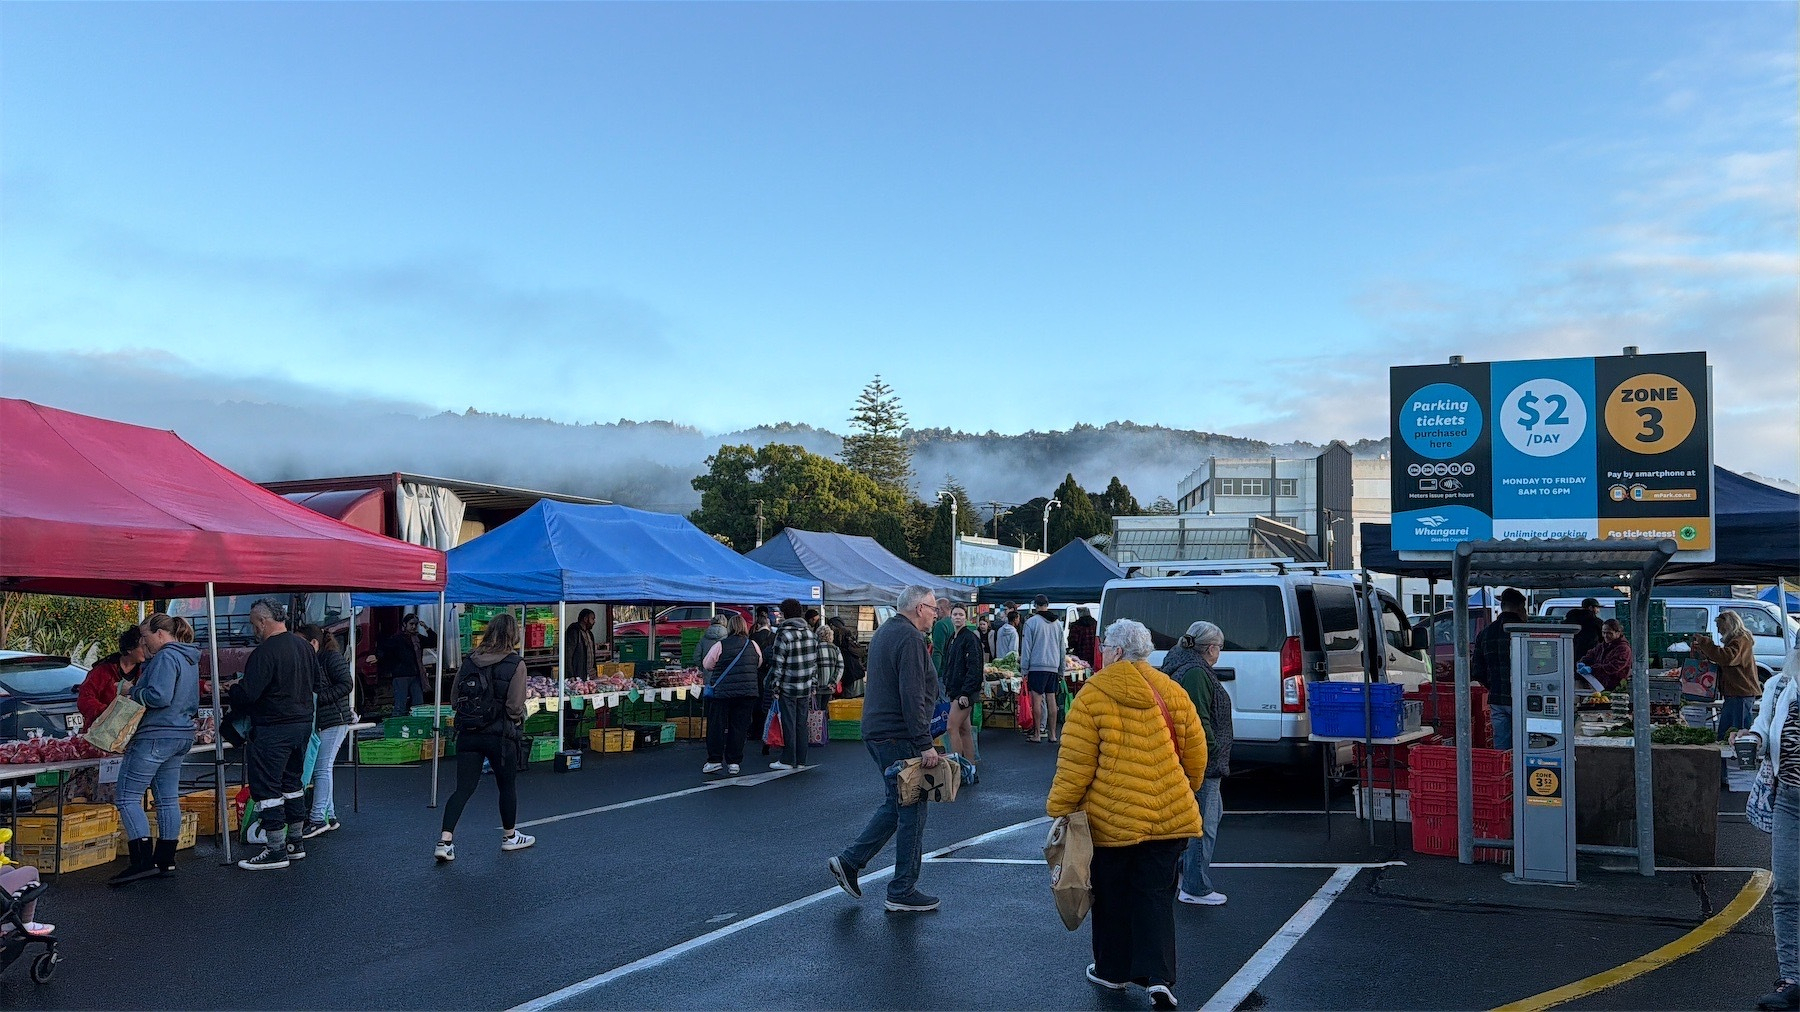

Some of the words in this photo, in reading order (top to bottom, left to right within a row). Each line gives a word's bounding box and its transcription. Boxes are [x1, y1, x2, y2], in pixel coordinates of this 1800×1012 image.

[1621, 387, 1678, 403] ZONE
[1413, 400, 1469, 412] Parking
[1517, 391, 1569, 431] $2
[1416, 415, 1466, 426] tickets
[1635, 406, 1664, 443] 3
[1414, 428, 1468, 439] purchased
[1429, 440, 1453, 448] here
[1526, 433, 1560, 447] /DAY
[1607, 471, 1622, 479] Pay
[1623, 470, 1634, 479] by
[1635, 469, 1685, 478] smartphone
[1541, 477, 1553, 485] TO
[1555, 476, 1587, 484] FRIDAY
[1415, 527, 1469, 537] Whangarei
[1503, 530, 1549, 538] Unlimited
[1623, 529, 1676, 538] ticketless!
[1536, 777, 1543, 787] 3
